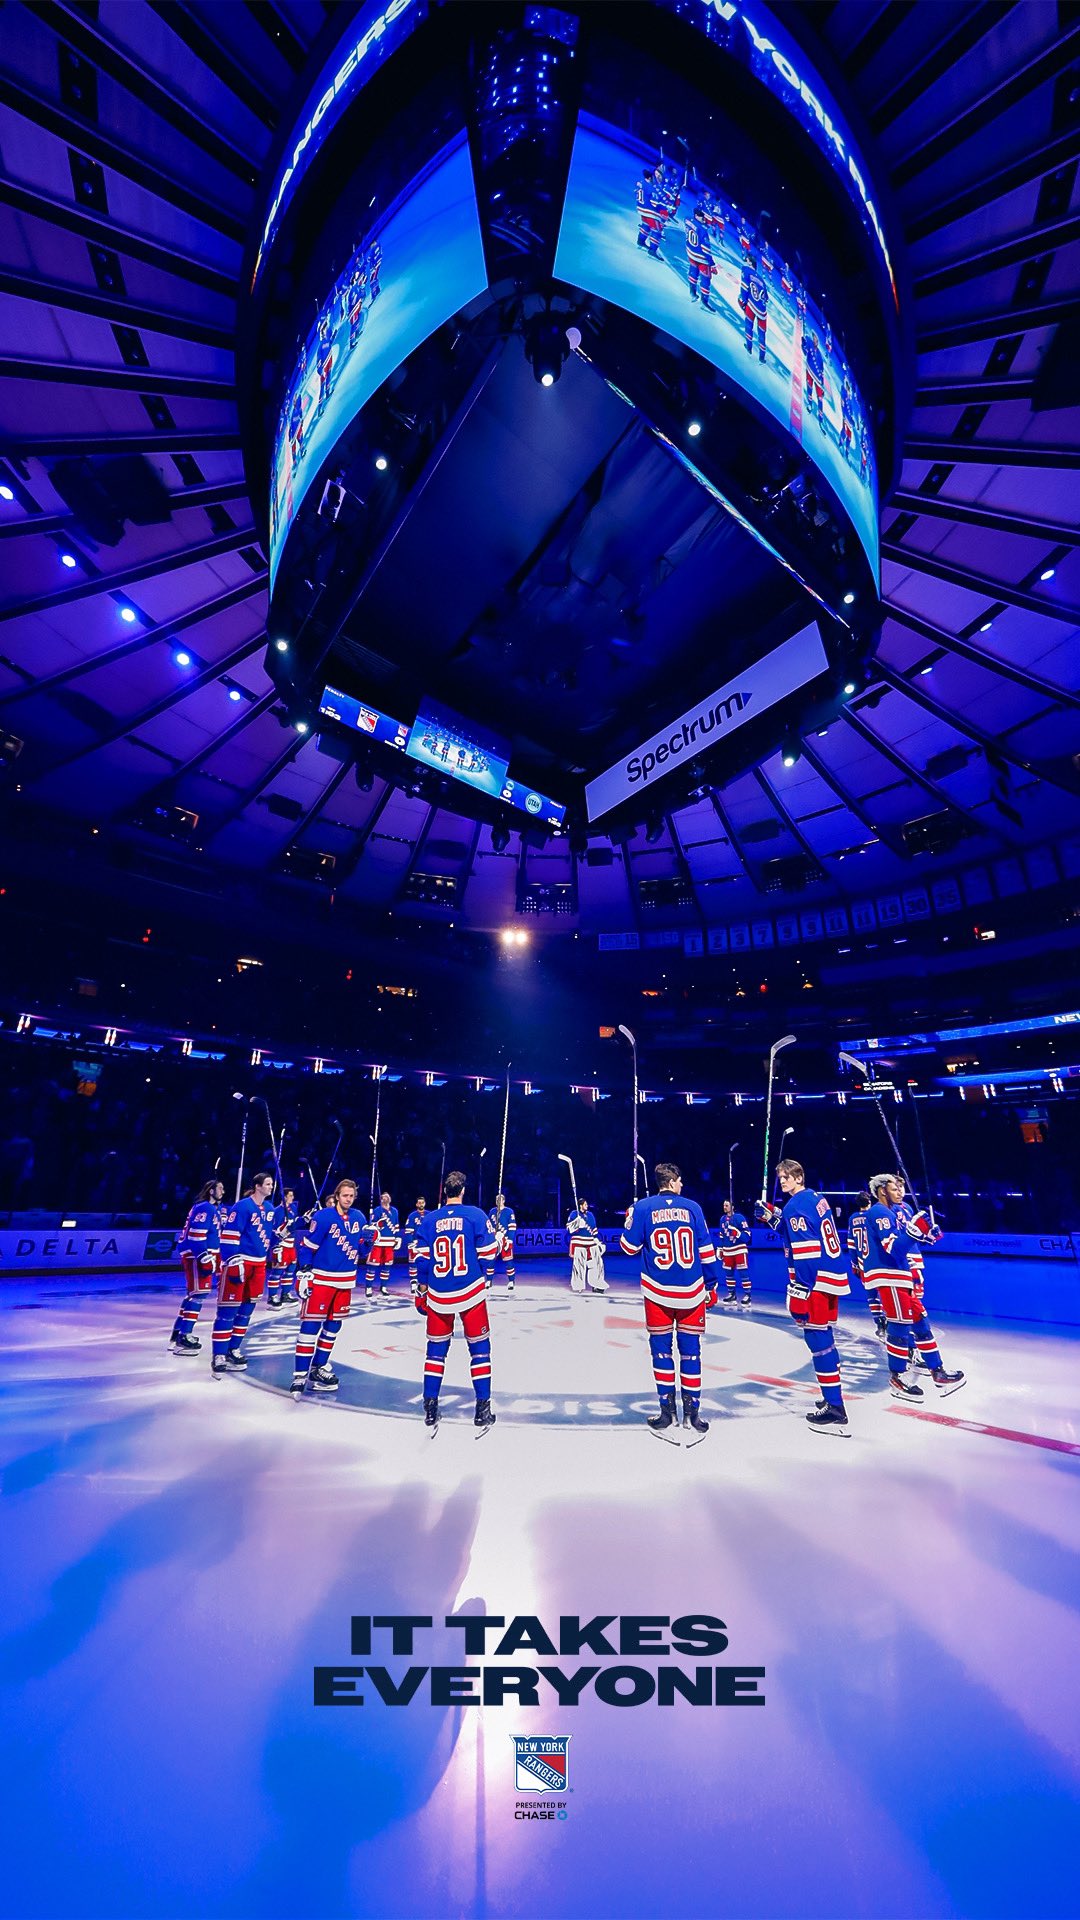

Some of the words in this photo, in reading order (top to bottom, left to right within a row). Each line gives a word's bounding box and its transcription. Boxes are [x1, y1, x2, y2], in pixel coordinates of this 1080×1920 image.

[741, 15, 846, 161] YORK
[626, 692, 744, 783] Spectrum
[435, 1217, 464, 1233] SMITH
[651, 1208, 691, 1225] MANCINI
[790, 1217, 807, 1232] 84
[876, 1217, 891, 1231] 79
[515, 1233, 562, 1247] CHASE
[820, 1215, 841, 1259] 8
[16, 1238, 119, 1257] DELTA
[433, 1233, 469, 1278] 91
[650, 1226, 695, 1270] 90
